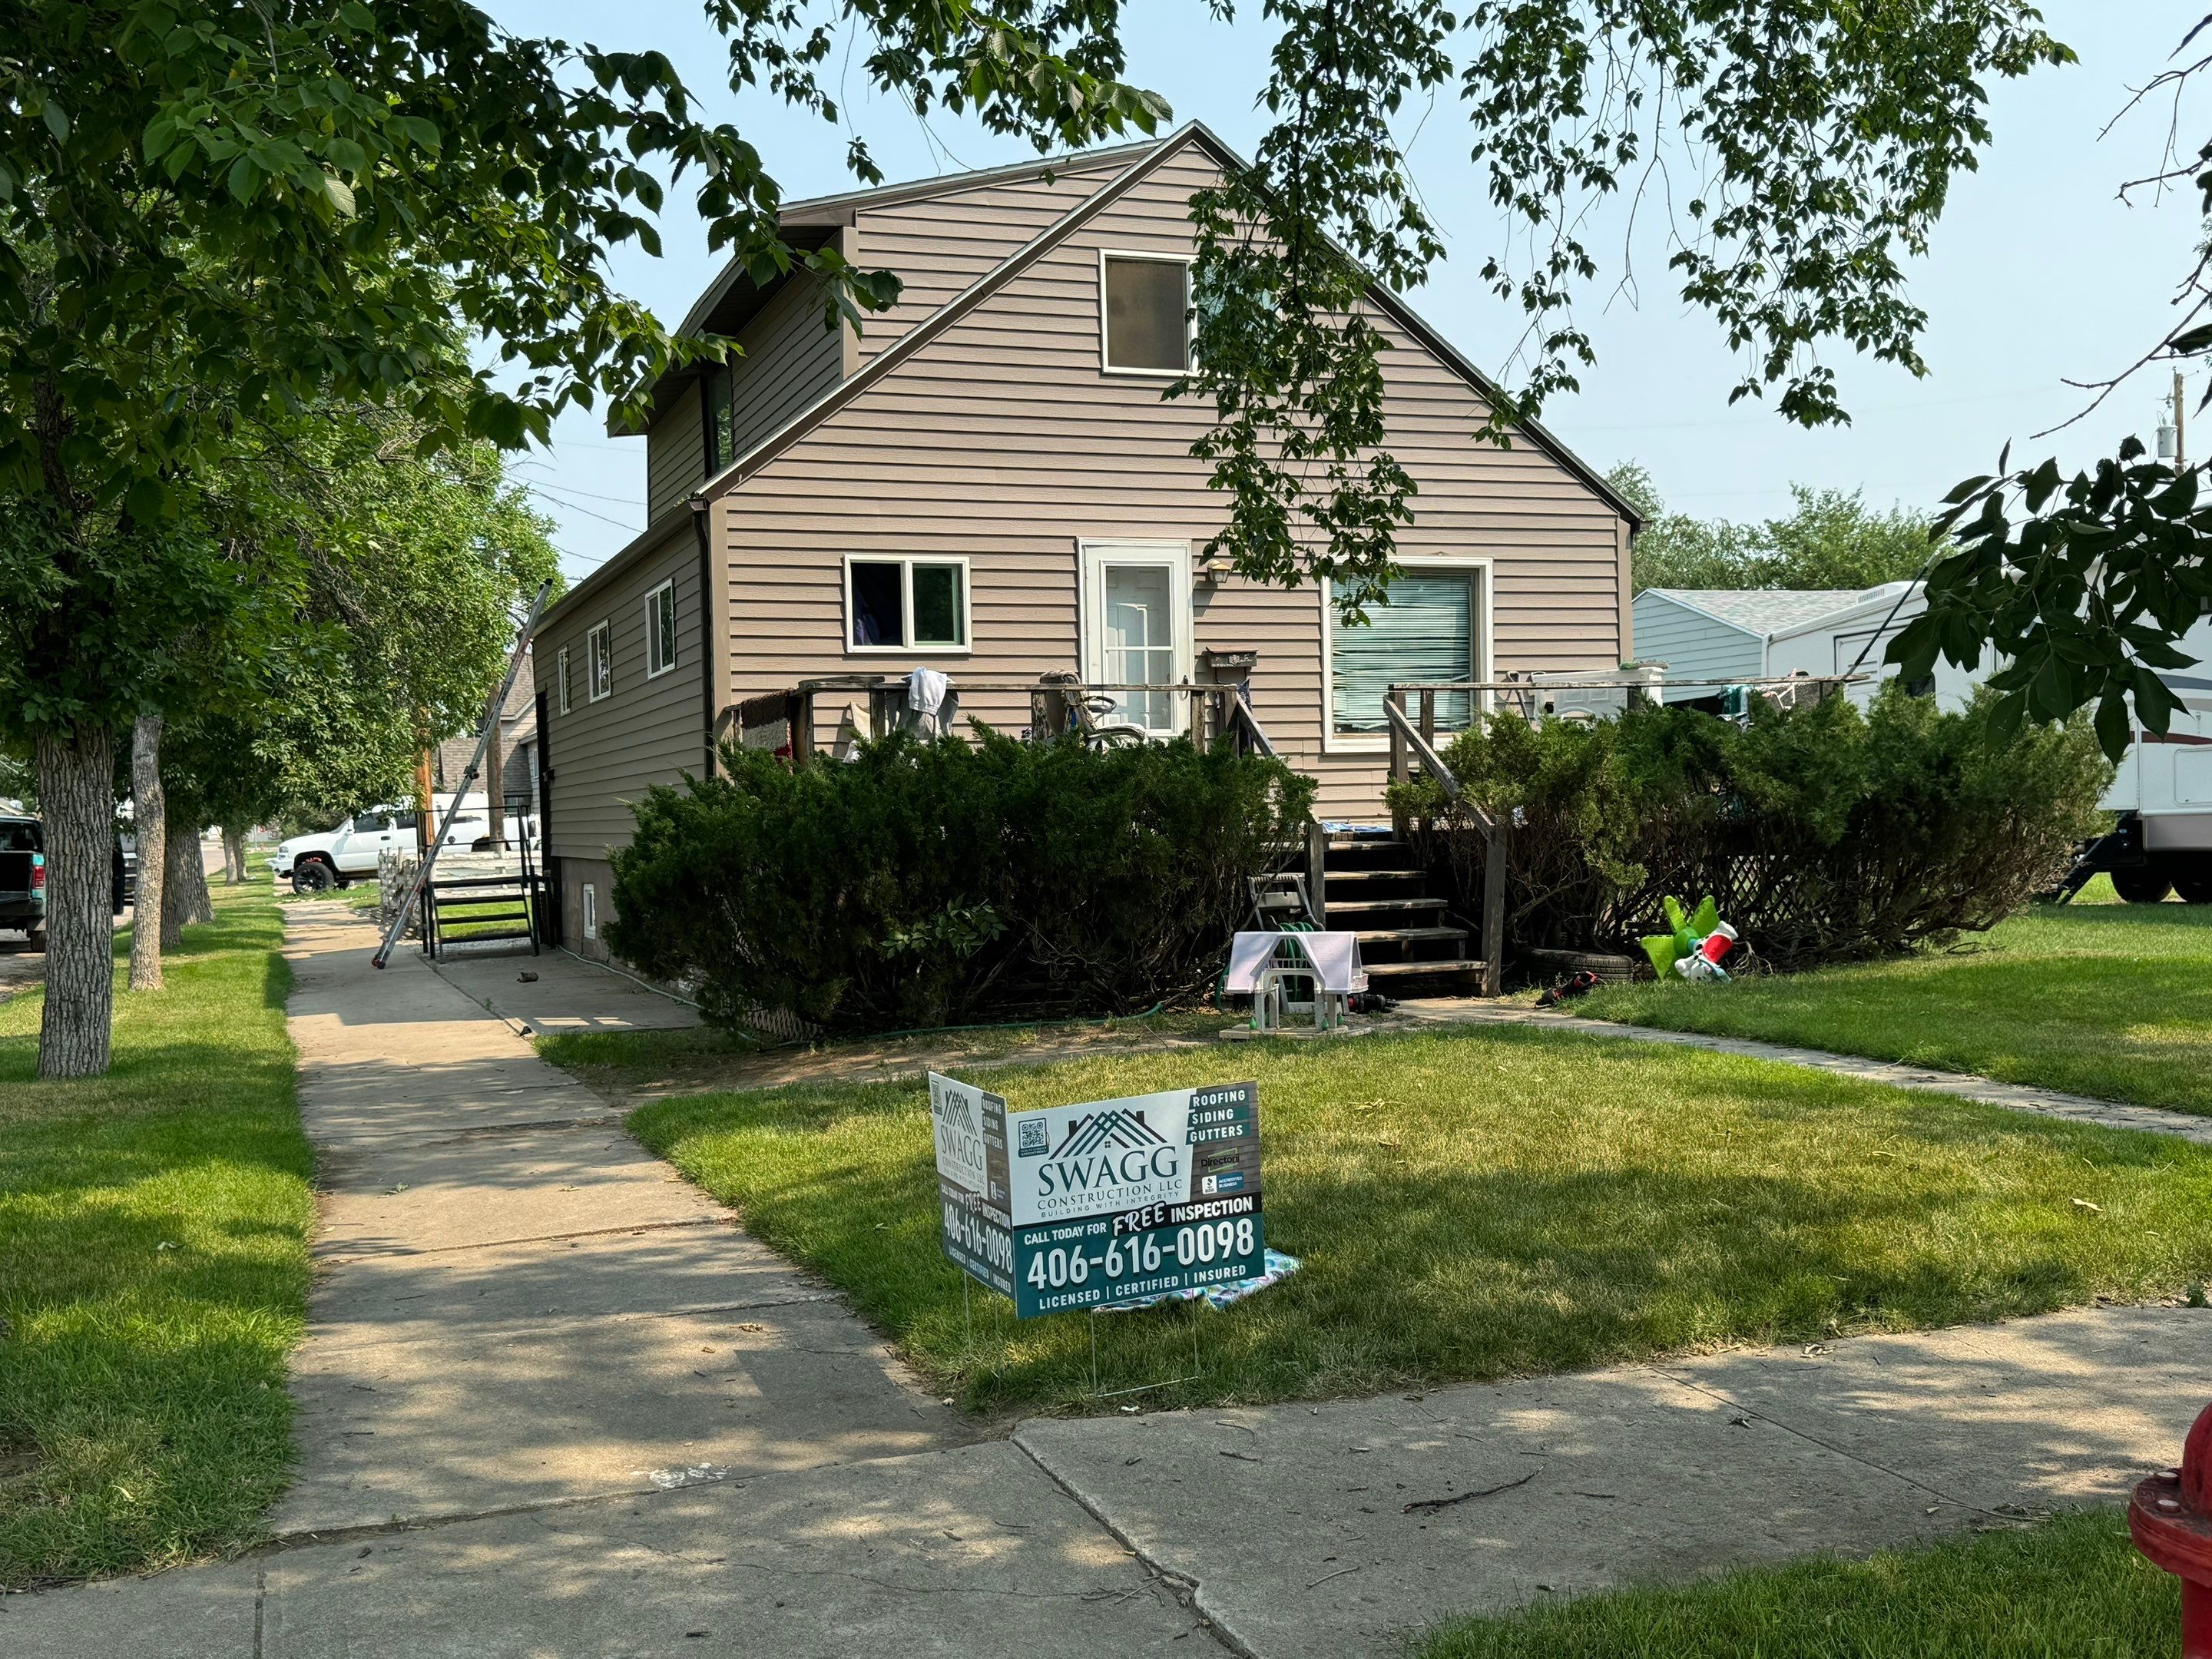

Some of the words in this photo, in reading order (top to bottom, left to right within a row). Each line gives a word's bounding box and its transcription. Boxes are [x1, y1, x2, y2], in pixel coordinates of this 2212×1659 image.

[1192, 1108, 1233, 1124] SIDING
[1193, 1089, 1246, 1108] ROOFING
[941, 1124, 982, 1171] SWAGG
[1190, 1124, 1243, 1143] GUTTERS
[1038, 1146, 1179, 1197] SWAGG
[965, 1192, 982, 1214] FREE
[1038, 1184, 1152, 1210] CONSTRUCTION
[1159, 1179, 1183, 1191] LLC
[1041, 1204, 1091, 1218] BUILDING
[1096, 1200, 1121, 1209] WITH
[1127, 1191, 1180, 1204] INTEGRITY
[944, 1202, 1013, 1274] 406-616-0098
[1024, 1232, 1050, 1245] CALL
[1052, 1225, 1084, 1241] TODAY
[1087, 1222, 1107, 1235] FOR
[1112, 1202, 1167, 1237] FREE
[1171, 1196, 1253, 1224] INSPECTION
[1028, 1218, 1254, 1290] 406-616-0098
[1039, 1289, 1101, 1310] LICENSED
[1115, 1276, 1179, 1296] CERTIFIED
[1194, 1265, 1246, 1283] INSURED
